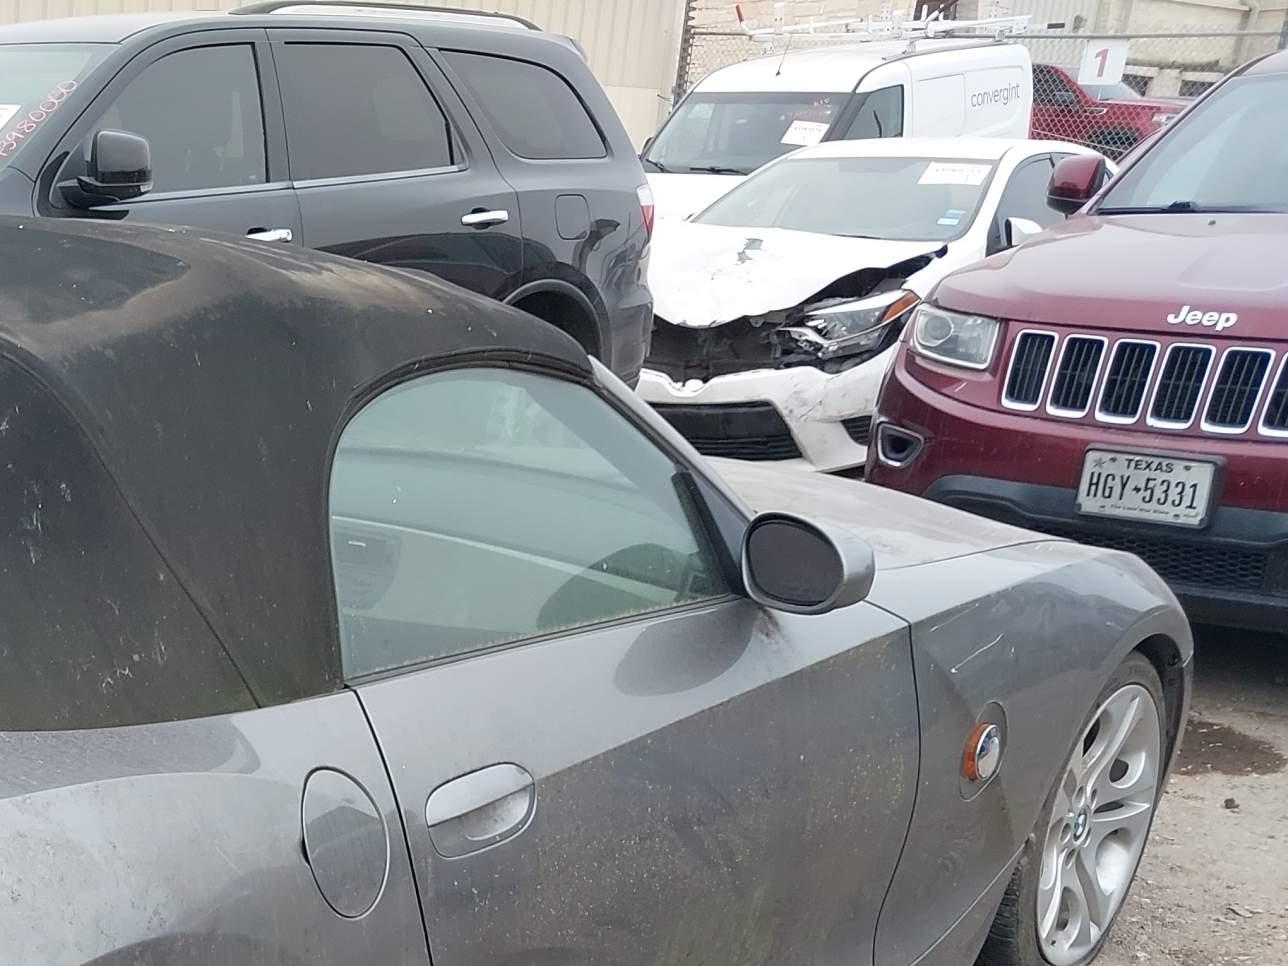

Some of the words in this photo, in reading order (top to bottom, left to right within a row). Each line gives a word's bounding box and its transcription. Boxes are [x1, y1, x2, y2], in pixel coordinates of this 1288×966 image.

[1094, 48, 1110, 78] 1
[970, 82, 1021, 107] convergint
[1167, 305, 1238, 331] Jeep
[1125, 458, 1174, 473] TEXAS
